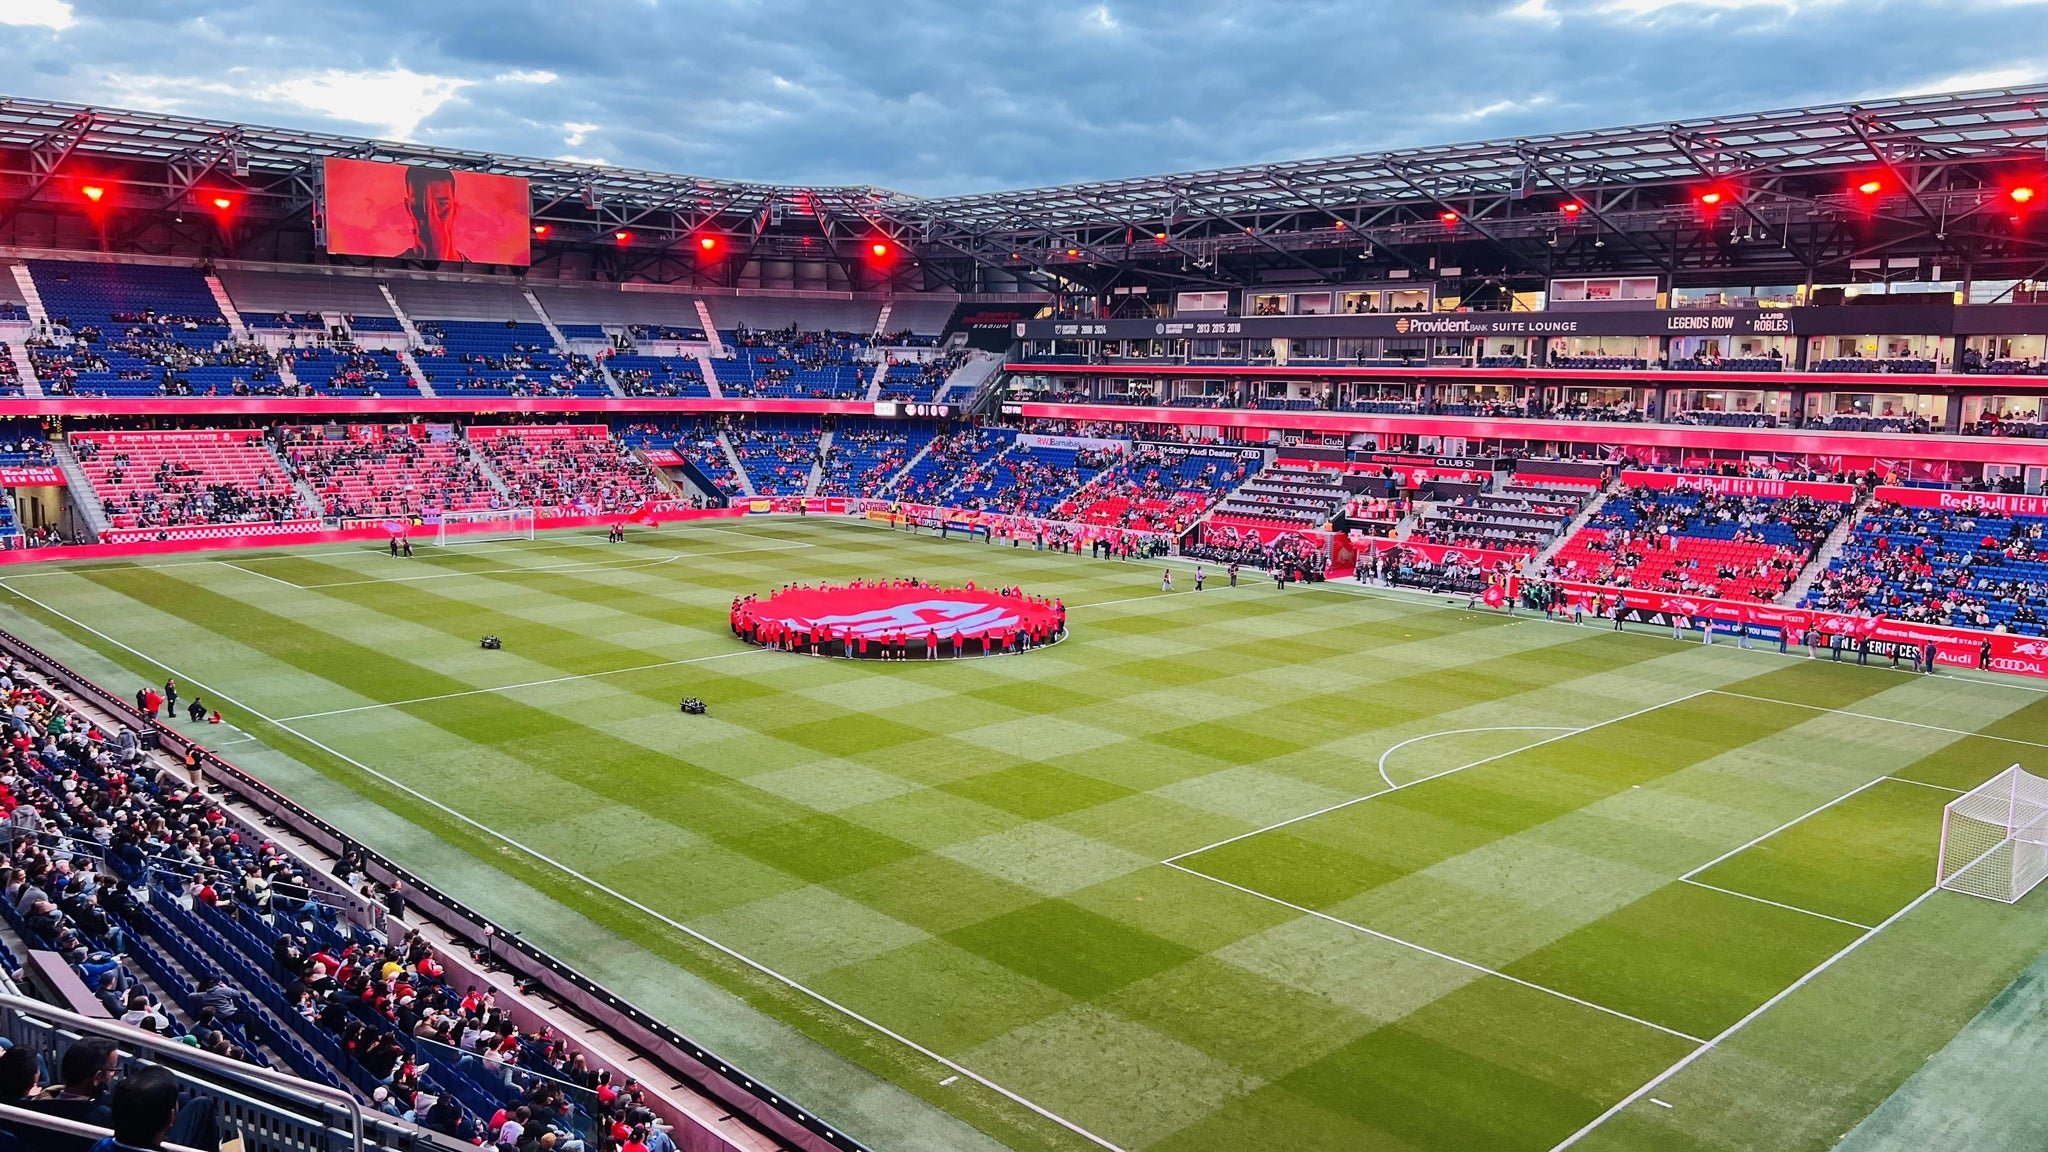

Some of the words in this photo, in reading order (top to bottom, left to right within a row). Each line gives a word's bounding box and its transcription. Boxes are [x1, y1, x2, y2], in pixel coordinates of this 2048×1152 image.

[1410, 318, 1470, 332] Provident
[1492, 322, 1524, 331] SUITE
[1528, 322, 1577, 331] LOUNGE
[1668, 317, 1709, 329] LEGENDS
[1711, 317, 1734, 328] ROW
[1754, 320, 1788, 331] ROBLES
[1324, 438, 1342, 446] Club
[1158, 446, 1188, 454] Tri-State
[1190, 448, 1207, 456] Audi
[1208, 450, 1237, 458] Dealers
[1464, 460, 1474, 468] SI
[29, 474, 58, 482] YORK
[1704, 478, 1728, 492] Bull
[1733, 480, 1754, 492] NEW
[1757, 482, 1784, 494] YORK
[1940, 494, 1972, 509] Red
[1974, 496, 2006, 510] Bull
[2010, 498, 2036, 512] NEW
[1936, 650, 1972, 664] Audi
